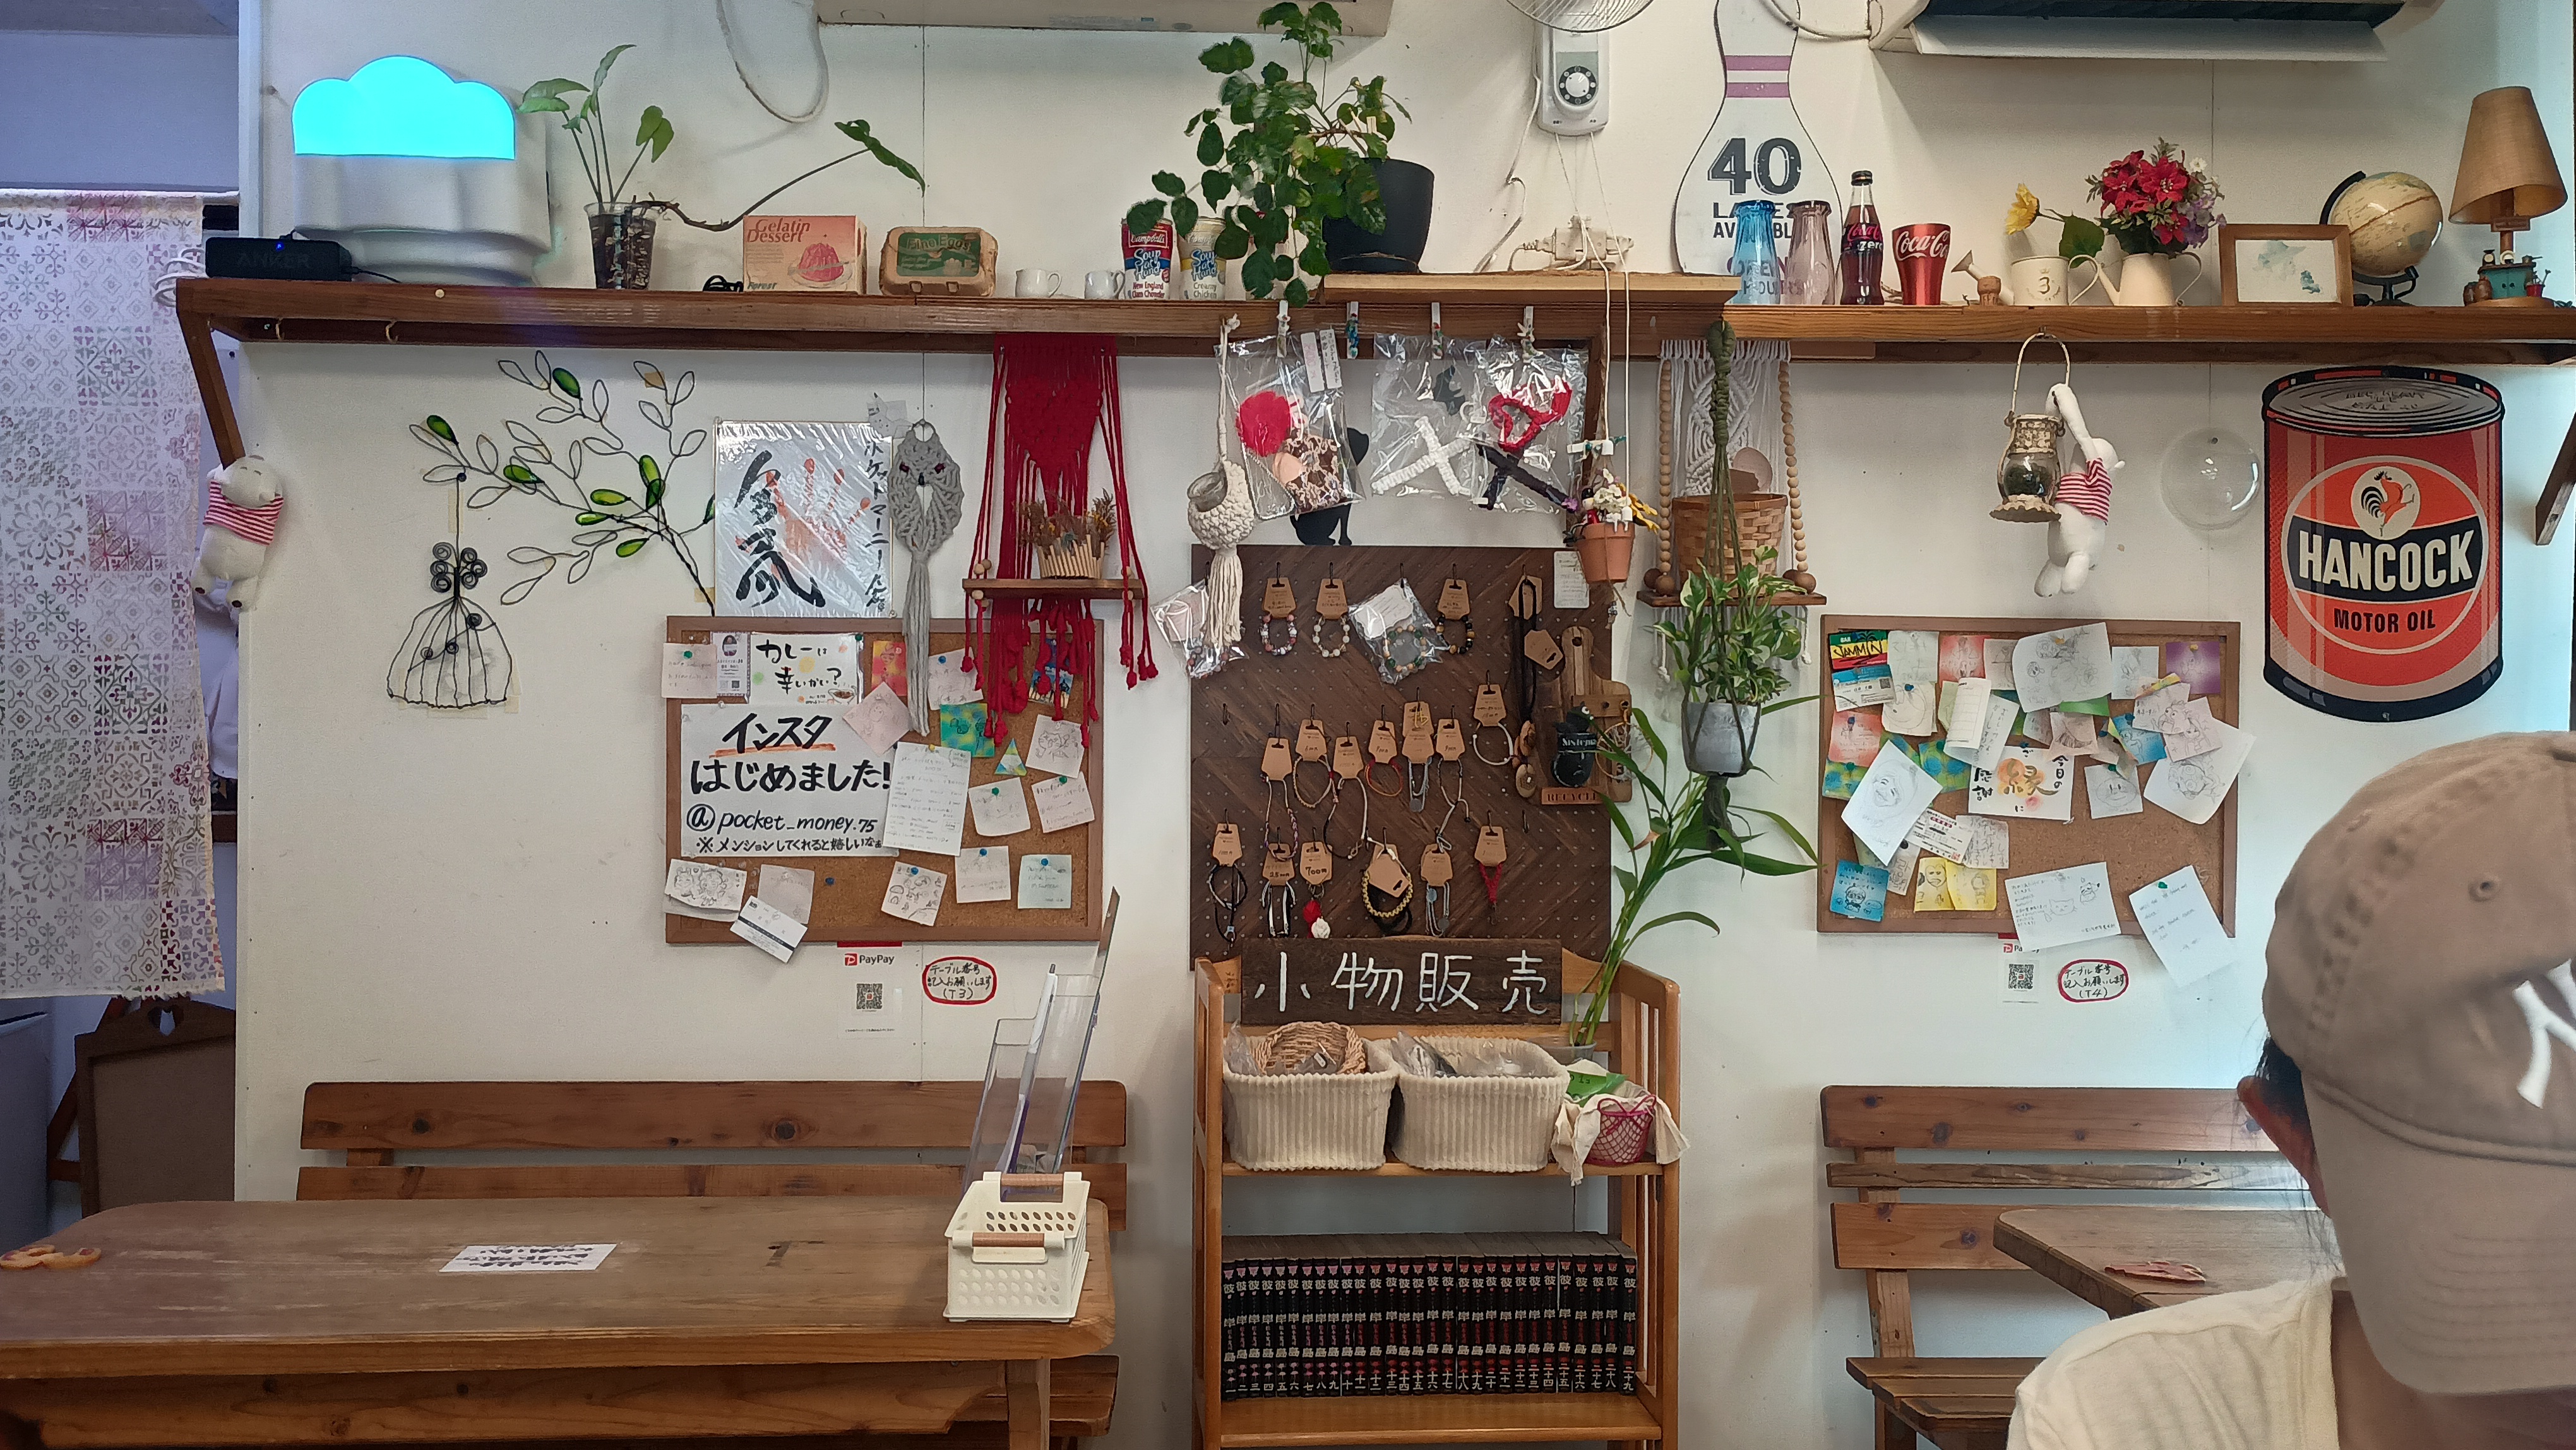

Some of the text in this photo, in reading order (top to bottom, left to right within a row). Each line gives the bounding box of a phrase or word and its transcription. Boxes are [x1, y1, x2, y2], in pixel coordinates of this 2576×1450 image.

[1707, 137, 1801, 195] 40
[755, 219, 811, 233] Gelatin
[747, 229, 803, 244] Dessert
[236, 253, 311, 269] ANKER
[1134, 249, 1162, 265] Soup
[1136, 262, 1160, 282] Hand
[1193, 263, 1217, 282] Hand
[1145, 282, 1164, 291] England
[1193, 282, 1217, 292] Creamy
[2039, 277, 2050, 294] 3
[2299, 529, 2476, 593] HANCOCK
[2334, 608, 2436, 633] MOTOR OIL
[756, 639, 828, 664] カレーは
[722, 712, 833, 753] インスタ
[690, 759, 891, 794] はじめました!
[2052, 755, 2069, 789] 今日の
[1972, 767, 1994, 801] 感謝
[859, 955, 895, 966] PayPay
[929, 962, 981, 975] テーブル番号
[2064, 964, 2111, 978] テーブル番号
[1255, 949, 1549, 1015] 小物販売
[1355, 1374, 1366, 1389] 十一
[1369, 1375, 1381, 1390] 十二
[1386, 1371, 1397, 1389] 十三
[1399, 1374, 1410, 1391] 十四
[1412, 1373, 1424, 1390] 十五
[1428, 1371, 1439, 1389] 十六
[1442, 1372, 1453, 1388] 十七
[1458, 1373, 1470, 1390] 十八
[1472, 1374, 1483, 1390] 十九
[1486, 1372, 1497, 1388] 二十
[1500, 1368, 1511, 1387] 二十一
[1515, 1365, 1526, 1387] 二十二
[1528, 1365, 1540, 1388] 二十三
[1543, 1363, 1555, 1386] 二十四
[1558, 1363, 1570, 1386] 二十五
[1574, 1365, 1586, 1389] 二十六
[1591, 1365, 1603, 1388] 二十七
[1606, 1363, 1616, 1388] 二十八
[1623, 1367, 1635, 1391] 二十九
[1249, 1382, 1261, 1391] 三
[1263, 1382, 1274, 1391] 四
[1277, 1382, 1287, 1391] 五
[1289, 1382, 1299, 1390] 六
[1303, 1382, 1314, 1391] 七
[1316, 1381, 1327, 1390] 八
[1328, 1381, 1339, 1390] 九
[1342, 1380, 1353, 1390] 十
